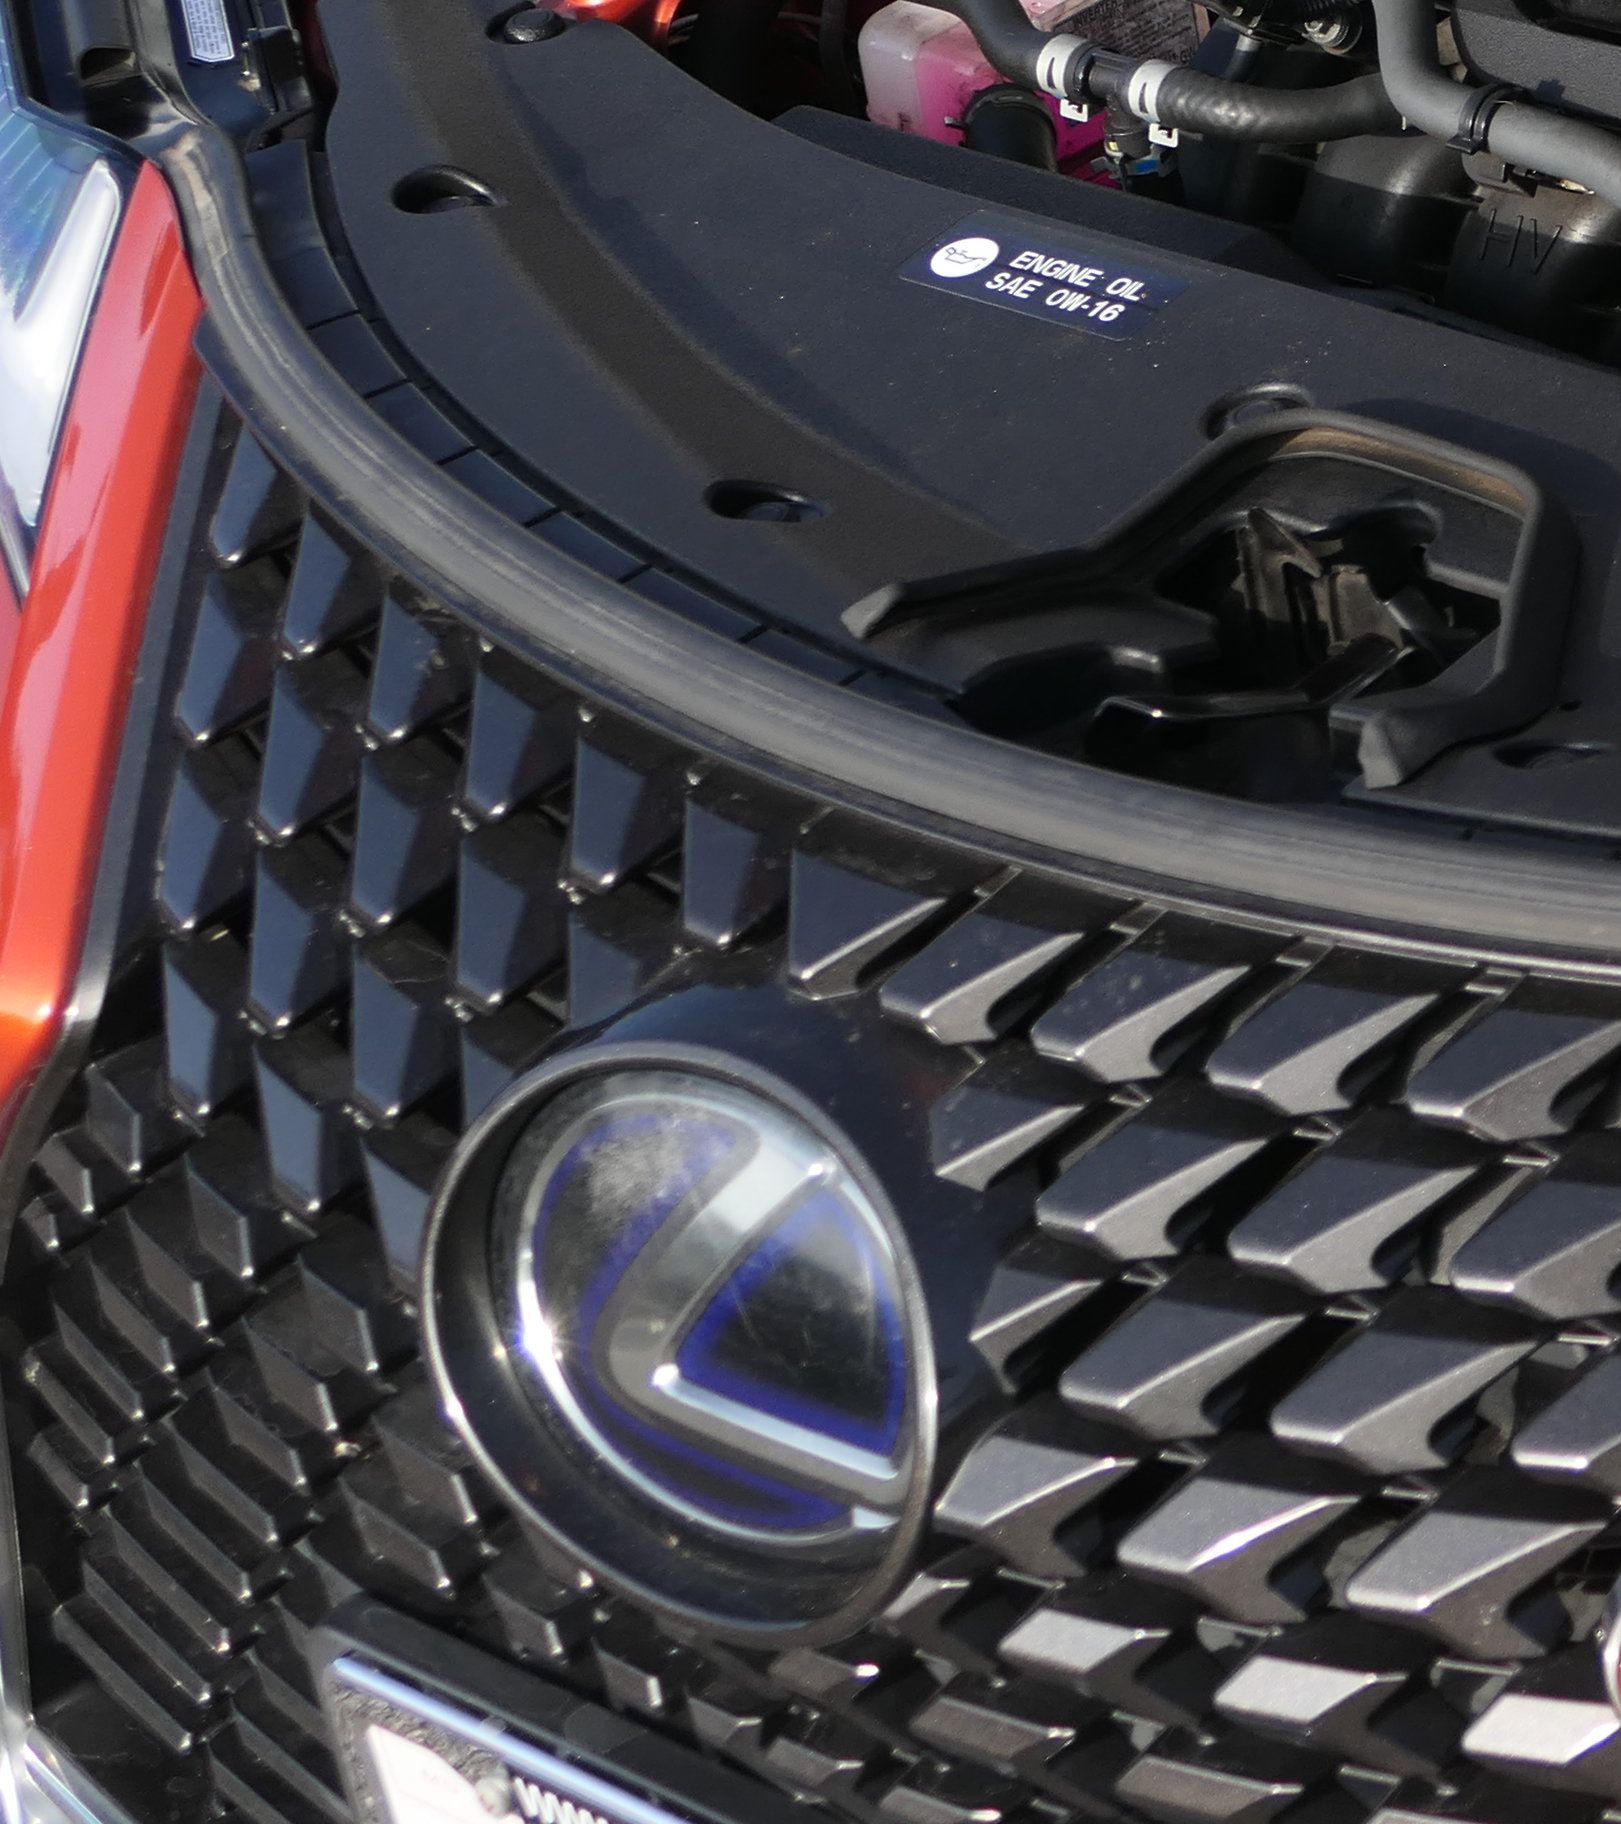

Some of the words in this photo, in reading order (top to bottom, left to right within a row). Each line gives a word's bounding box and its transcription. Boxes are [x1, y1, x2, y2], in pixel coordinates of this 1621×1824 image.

[1477, 207, 1564, 276] HV
[985, 271, 1041, 300] SAE
[1045, 286, 1126, 323] 0W-16
[1009, 250, 1105, 289] ENGINE
[1105, 276, 1145, 303] OIL
